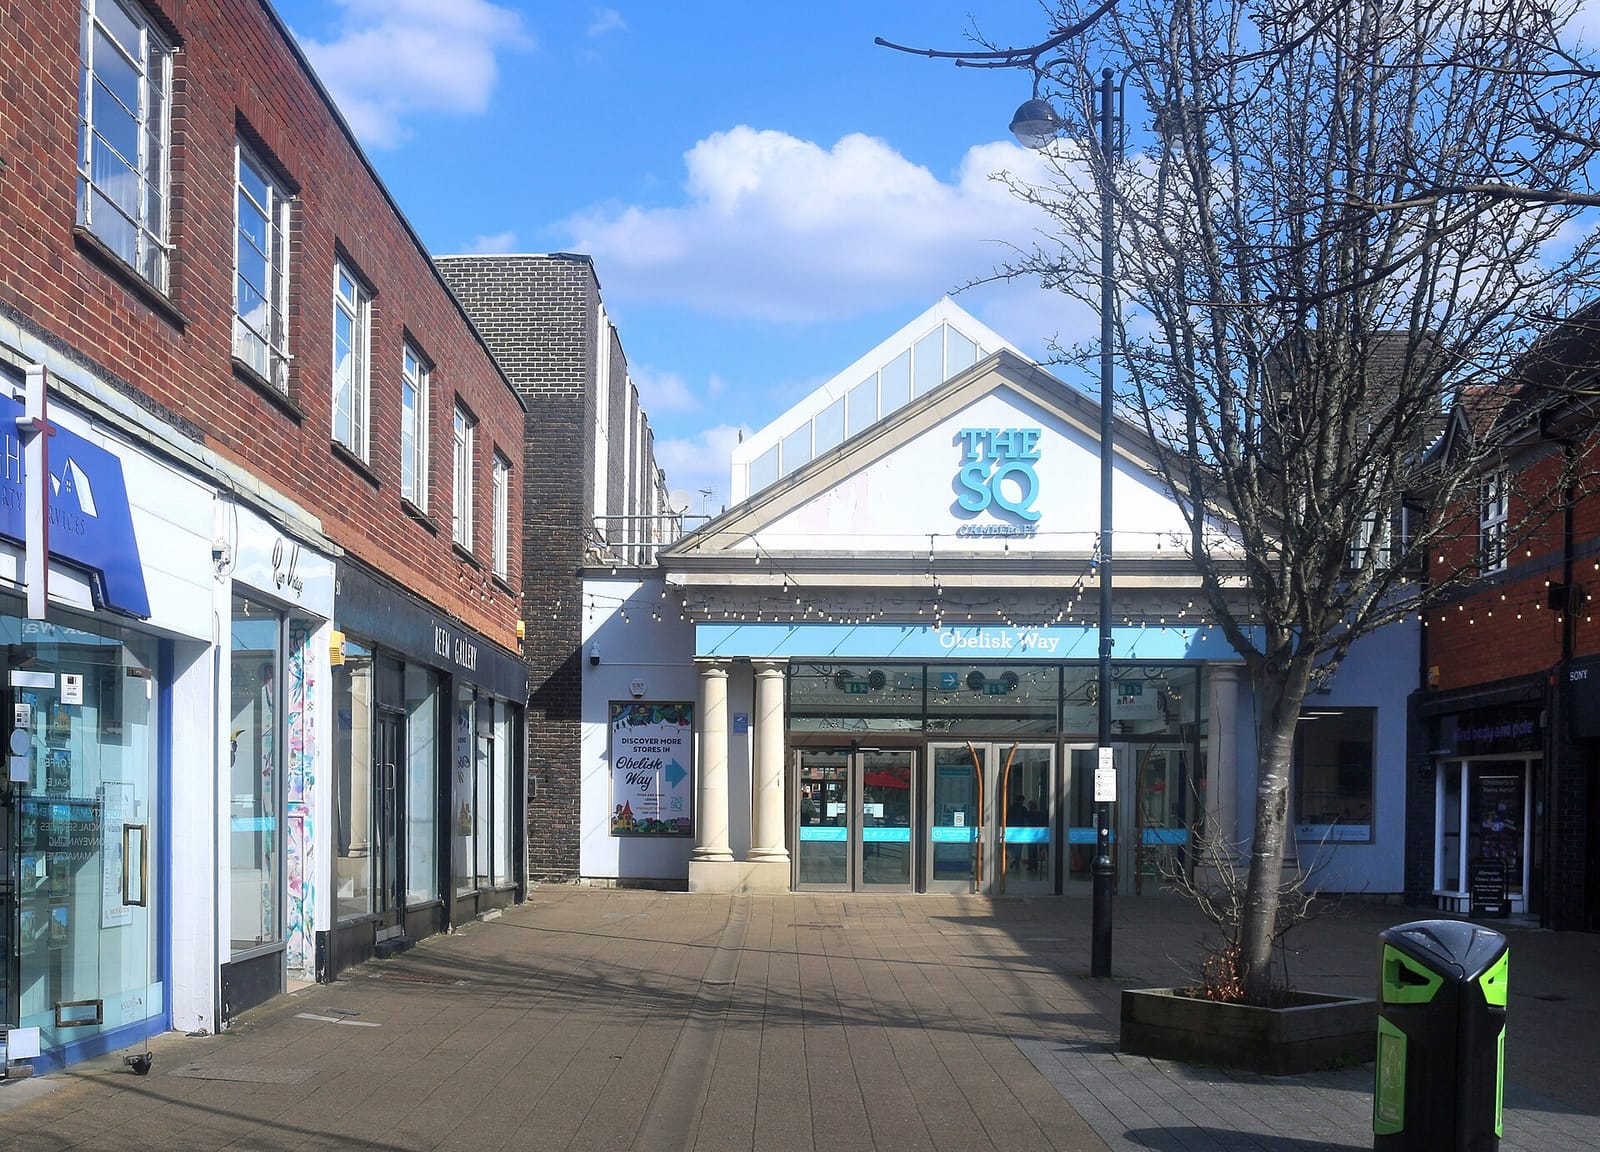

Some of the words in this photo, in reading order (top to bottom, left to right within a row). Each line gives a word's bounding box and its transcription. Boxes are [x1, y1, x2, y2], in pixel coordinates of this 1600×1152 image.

[959, 428, 1041, 460] THE
[955, 461, 1042, 521] SQ
[957, 524, 1040, 538] CAMBERLEY
[434, 626, 451, 660] REEM
[454, 636, 478, 673] GALLERY
[939, 631, 1012, 650] Obelisk
[1018, 633, 1060, 652] Way
[1569, 668, 1589, 682] SONY
[616, 756, 663, 770] Obelisk
[626, 770, 653, 792] Way
